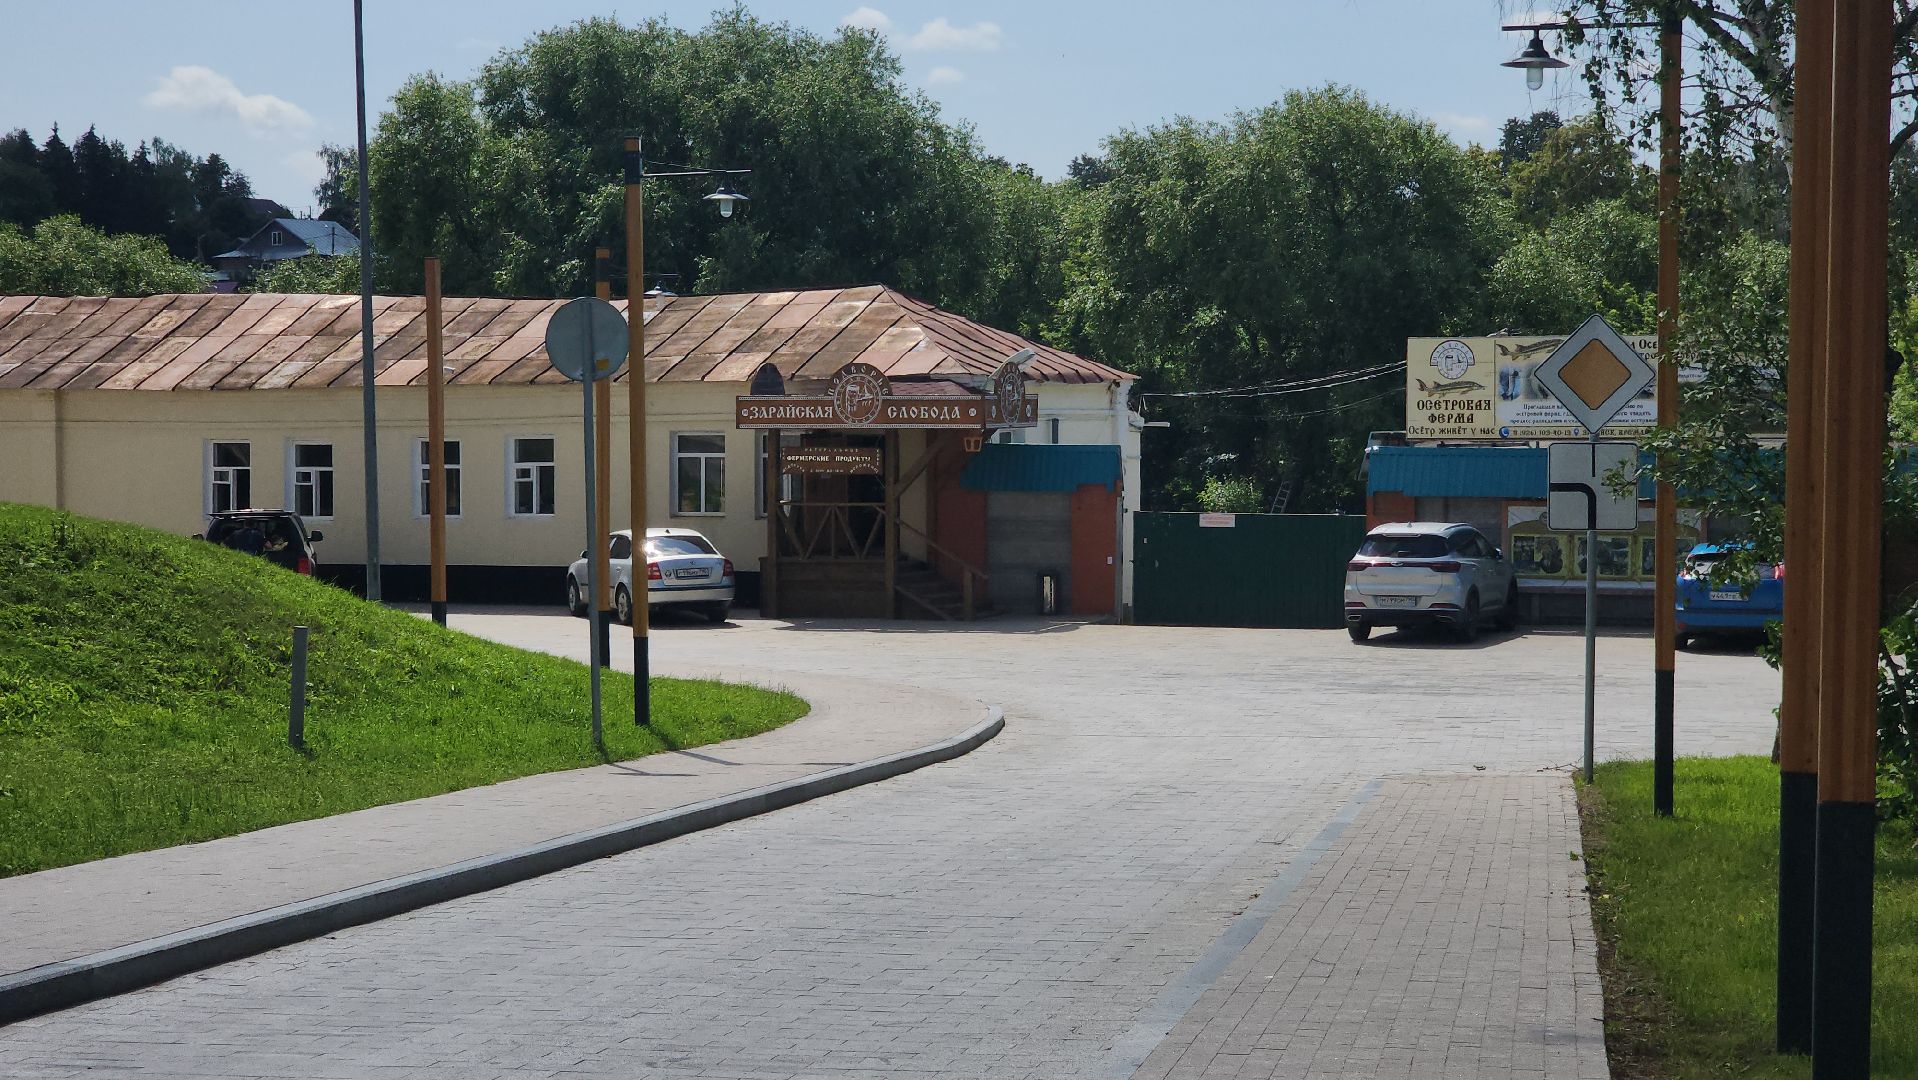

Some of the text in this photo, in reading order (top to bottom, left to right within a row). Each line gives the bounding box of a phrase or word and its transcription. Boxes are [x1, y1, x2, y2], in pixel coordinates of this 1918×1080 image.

[1417, 400, 1491, 411] ОСЕТРОВАЯ
[749, 404, 833, 420] ЗАРАЙСКАЯ
[887, 406, 960, 420] СЛОБОДА
[1428, 413, 1474, 423] ФЕРМА
[1408, 425, 1435, 437] Осётр
[1438, 426, 1467, 435] живёт
[1480, 427, 1495, 435] нас
